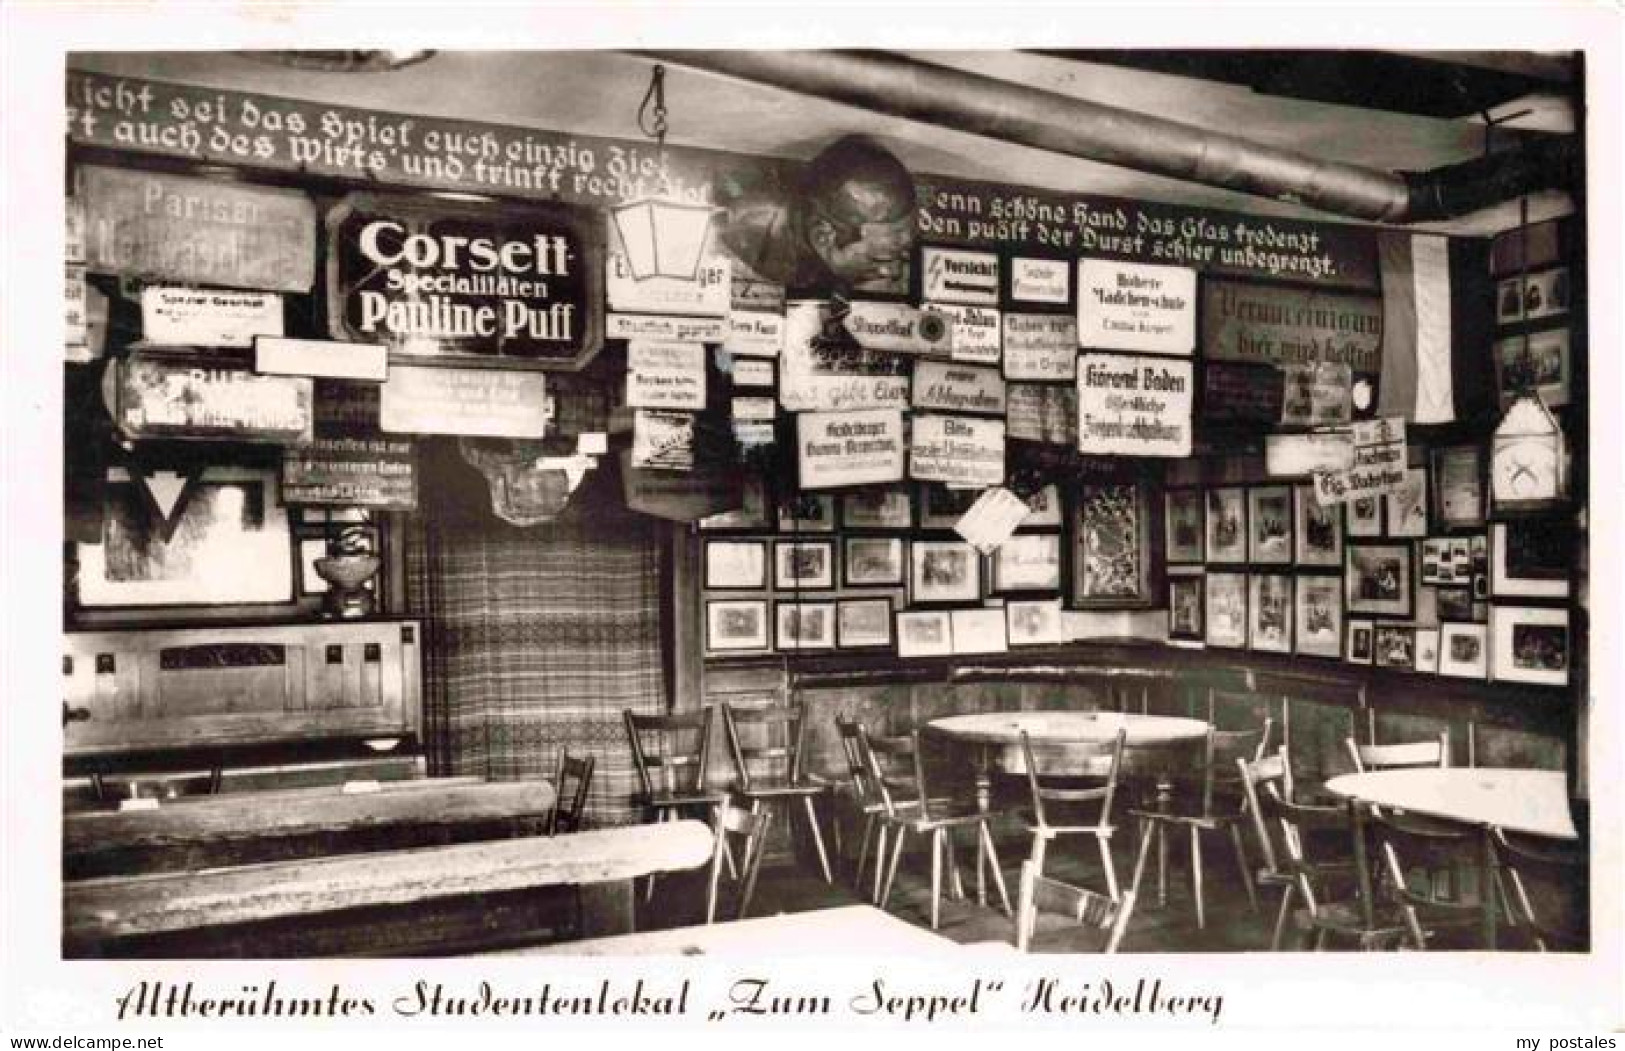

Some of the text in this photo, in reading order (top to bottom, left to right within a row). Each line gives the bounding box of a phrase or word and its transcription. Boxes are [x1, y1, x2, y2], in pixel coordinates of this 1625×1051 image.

[84, 78, 155, 116] icht
[170, 94, 226, 123] sei
[240, 99, 307, 134] das
[424, 130, 500, 160] euch
[506, 136, 595, 172] einzig
[114, 120, 201, 155] auch
[209, 126, 275, 159] des
[403, 151, 463, 180] und
[918, 207, 961, 235] den
[1036, 221, 1073, 248] der
[1081, 224, 1144, 254] Durst
[990, 195, 1066, 226] schöne
[1136, 208, 1175, 235] das
[360, 290, 574, 340] Pauline Puff
